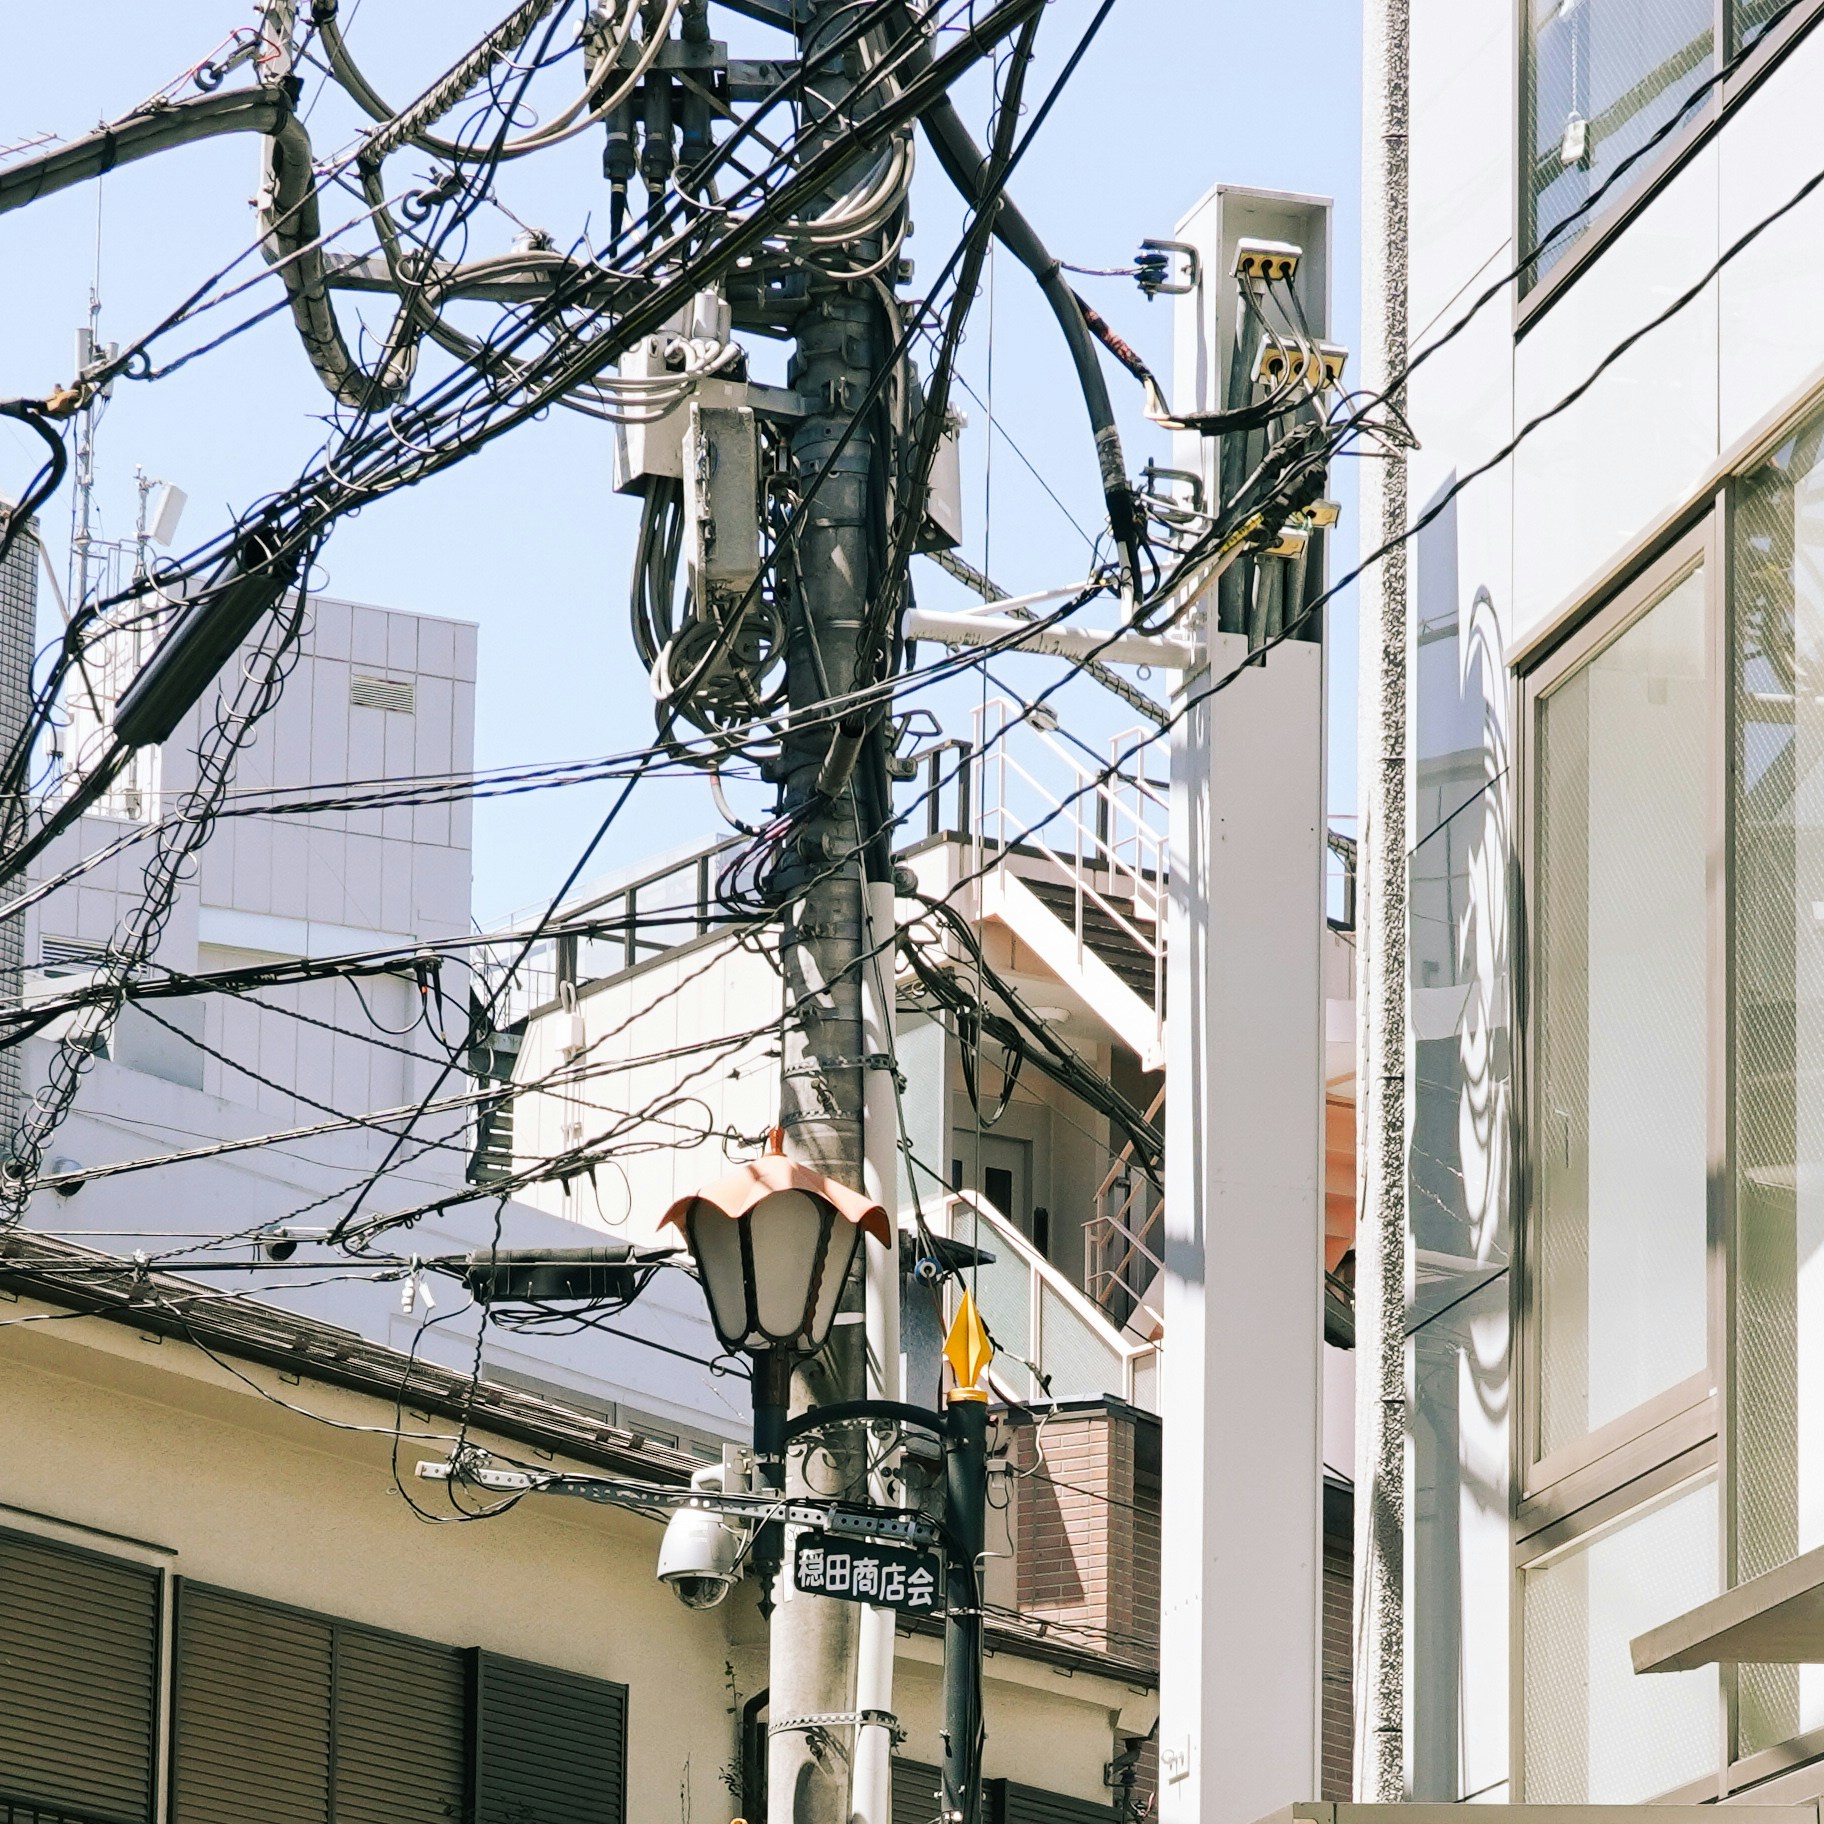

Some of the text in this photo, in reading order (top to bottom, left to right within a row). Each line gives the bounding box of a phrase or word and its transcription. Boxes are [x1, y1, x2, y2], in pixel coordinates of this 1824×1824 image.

[797, 1548, 934, 1607] 穏田商店会
